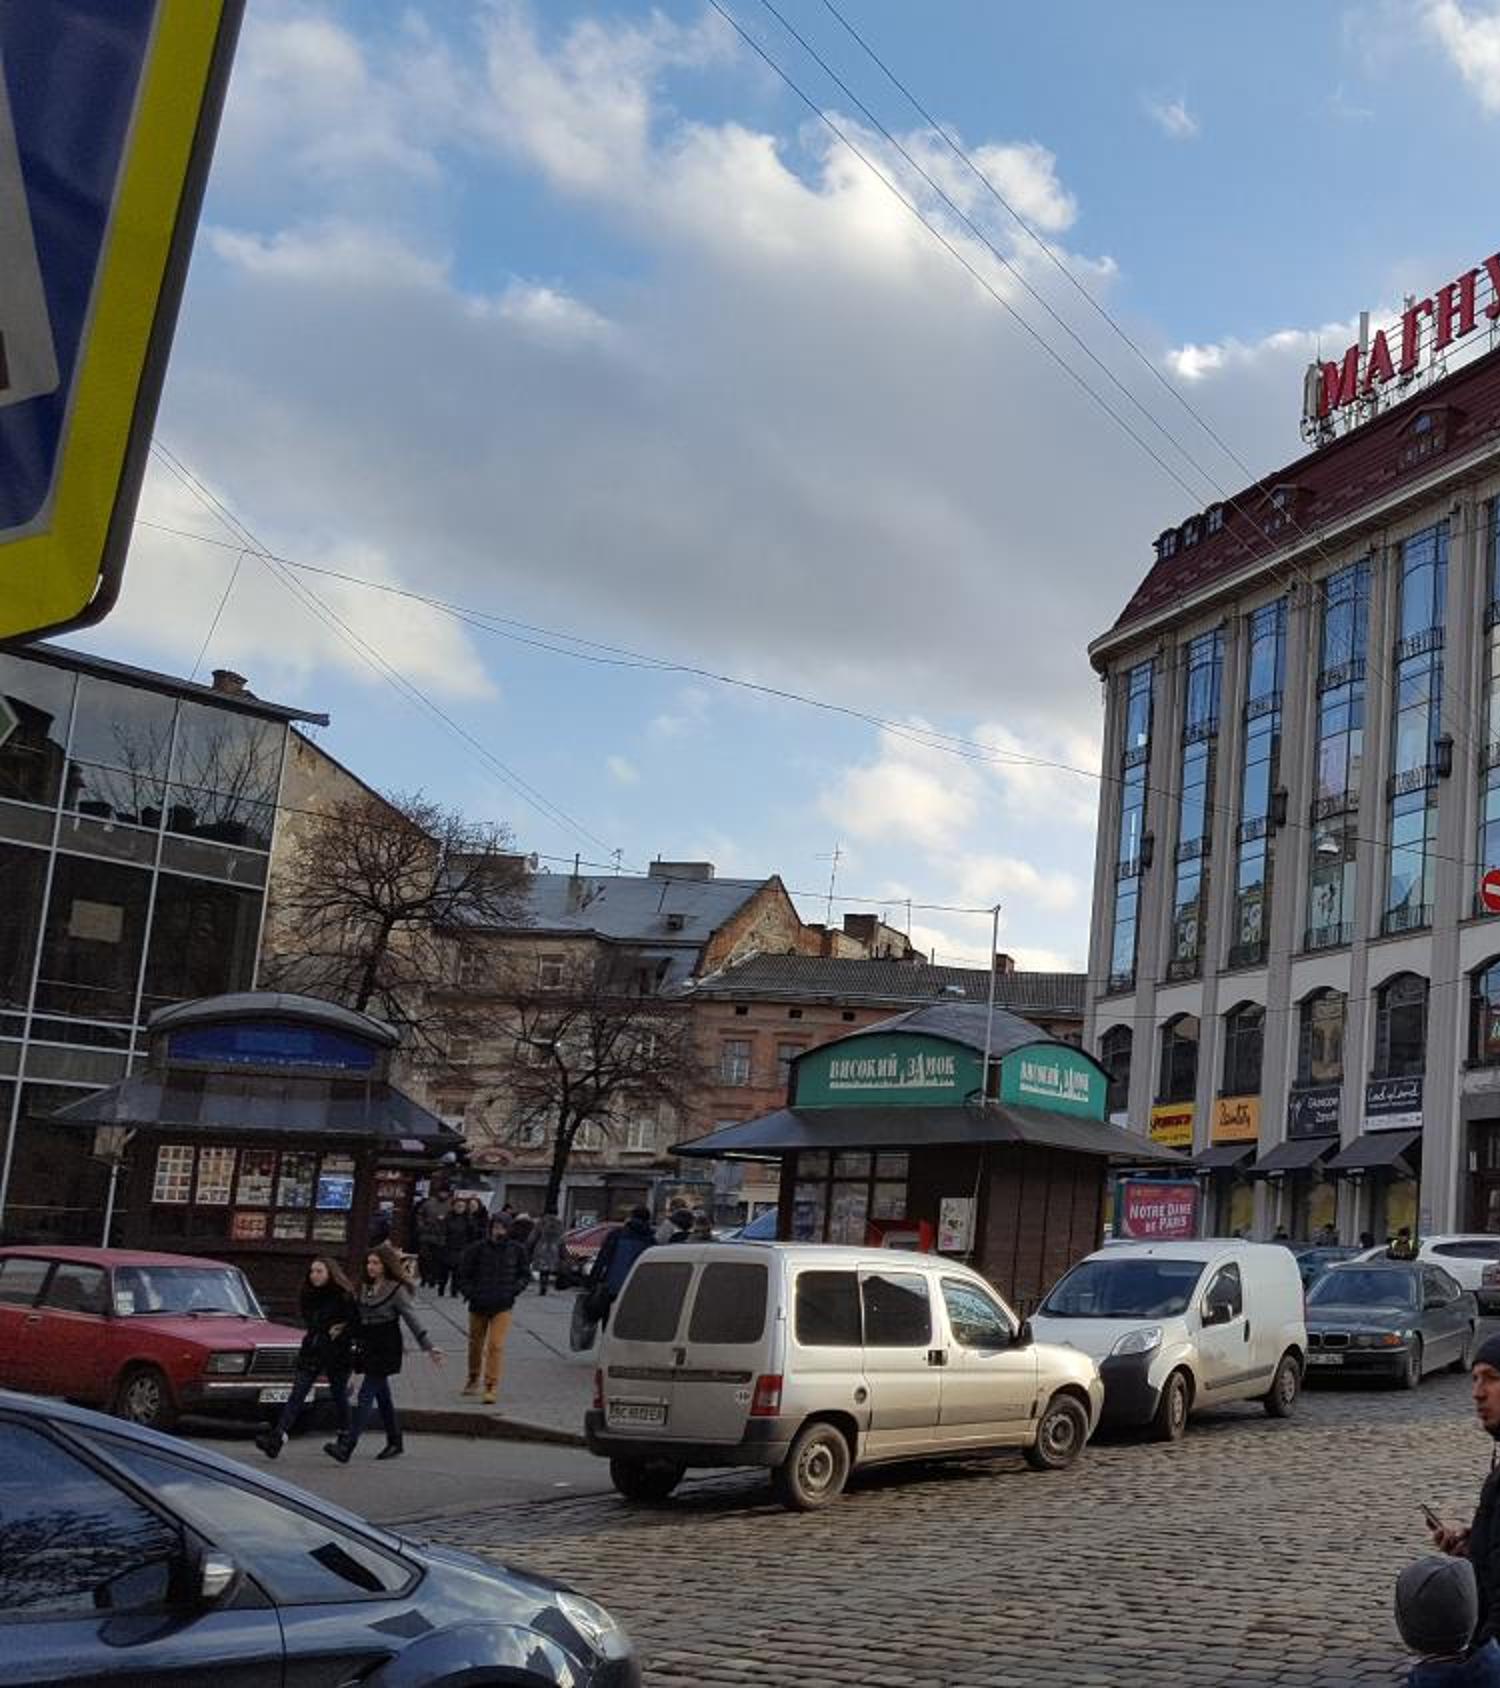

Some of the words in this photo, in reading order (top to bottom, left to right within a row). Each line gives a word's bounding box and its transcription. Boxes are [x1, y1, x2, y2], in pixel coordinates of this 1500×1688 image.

[829, 1053, 897, 1079] ВИСОКИЙ
[907, 1052, 954, 1080] ЗАМОК
[1130, 1204, 1165, 1219] NOTRE
[1167, 1203, 1192, 1216] DAME
[1160, 1216, 1187, 1230] PARIS
